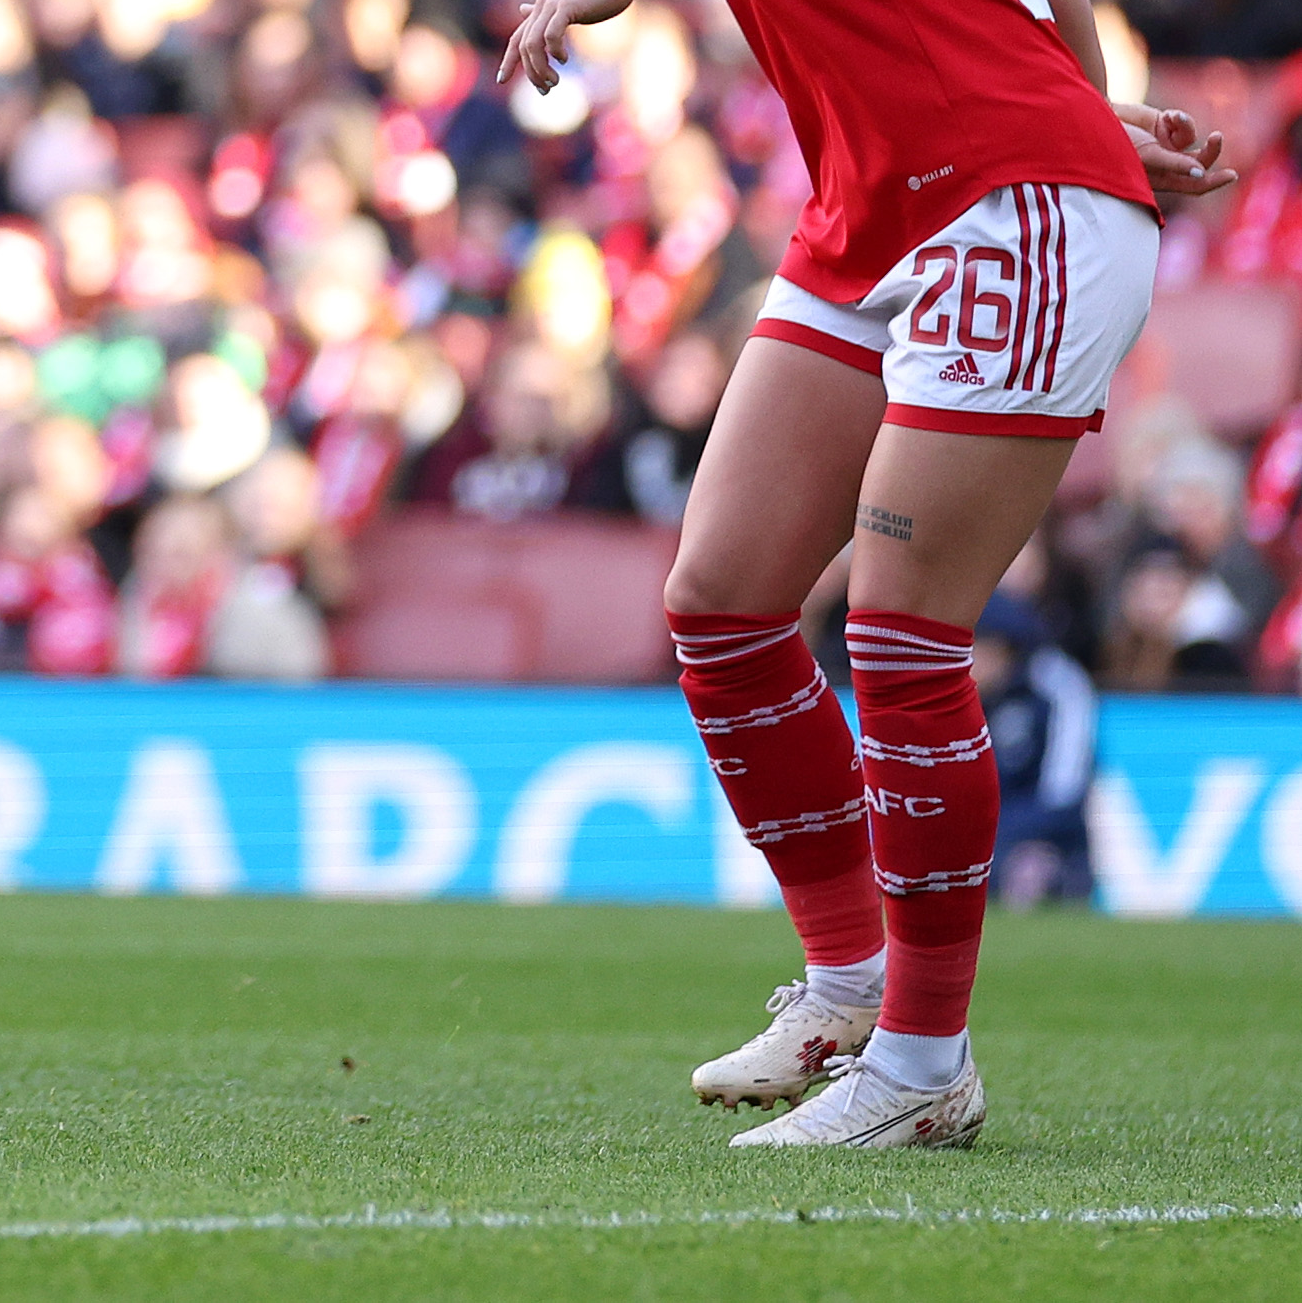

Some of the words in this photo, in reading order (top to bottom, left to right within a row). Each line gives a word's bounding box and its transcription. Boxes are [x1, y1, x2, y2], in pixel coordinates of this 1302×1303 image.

[908, 245, 1015, 352] 26
[939, 369, 985, 386] adidas
[864, 782, 946, 818] AFC
